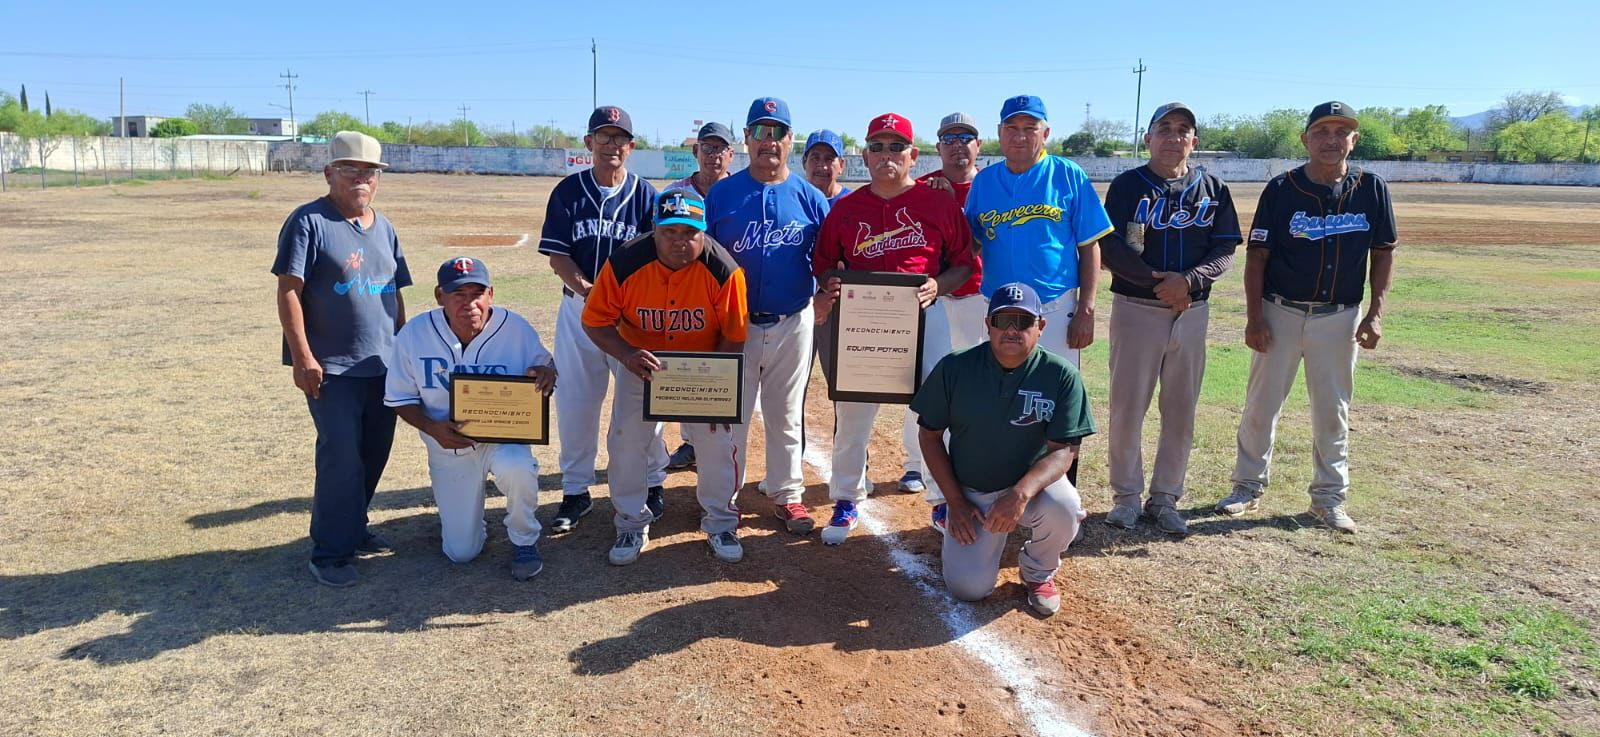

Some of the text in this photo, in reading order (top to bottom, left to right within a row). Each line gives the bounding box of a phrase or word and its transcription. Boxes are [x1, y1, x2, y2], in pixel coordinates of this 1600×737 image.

[608, 107, 621, 122] B
[764, 101, 777, 113] C
[1330, 102, 1342, 115] P
[674, 193, 690, 215] LA
[1134, 197, 1219, 230] Met
[572, 218, 641, 241] ANKEE
[733, 220, 804, 252] Mets
[1006, 286, 1024, 301] TB
[845, 327, 911, 335] RECONOCIMIENTO
[462, 408, 532, 417] RECONOCIMIENTO
[1018, 389, 1056, 423] TB
